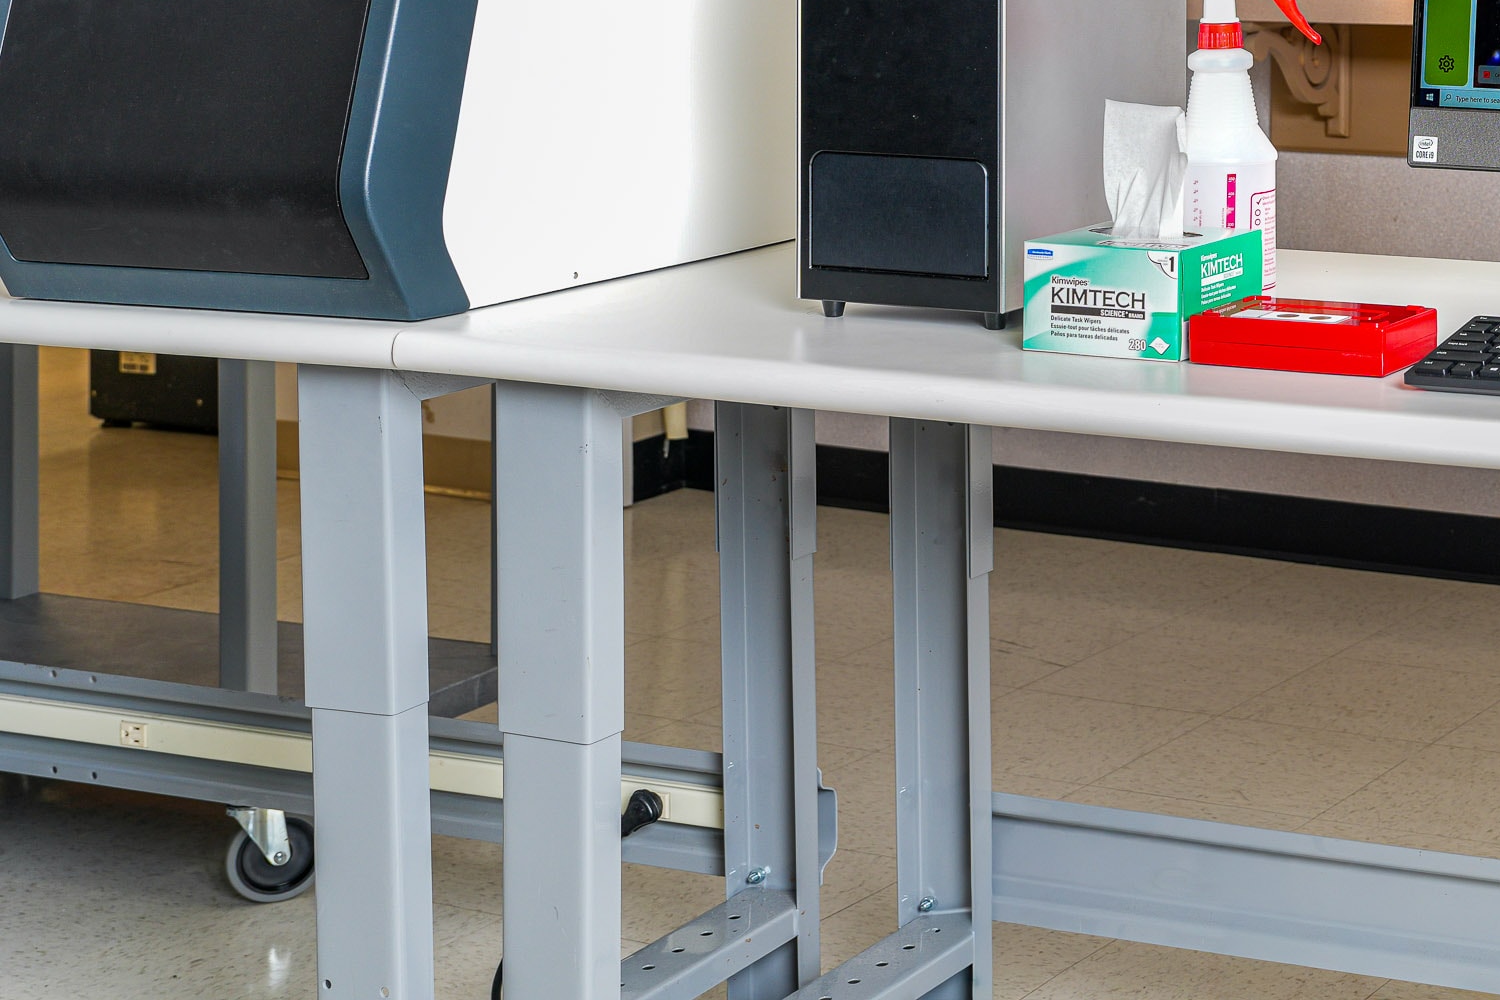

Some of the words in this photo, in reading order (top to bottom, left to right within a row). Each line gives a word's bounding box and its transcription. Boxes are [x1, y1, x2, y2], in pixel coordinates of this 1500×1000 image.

[1169, 256, 1175, 273] 1
[1201, 253, 1243, 278] KIMTECH
[1051, 287, 1145, 309] KIMTECH
[1128, 339, 1146, 351] 280
